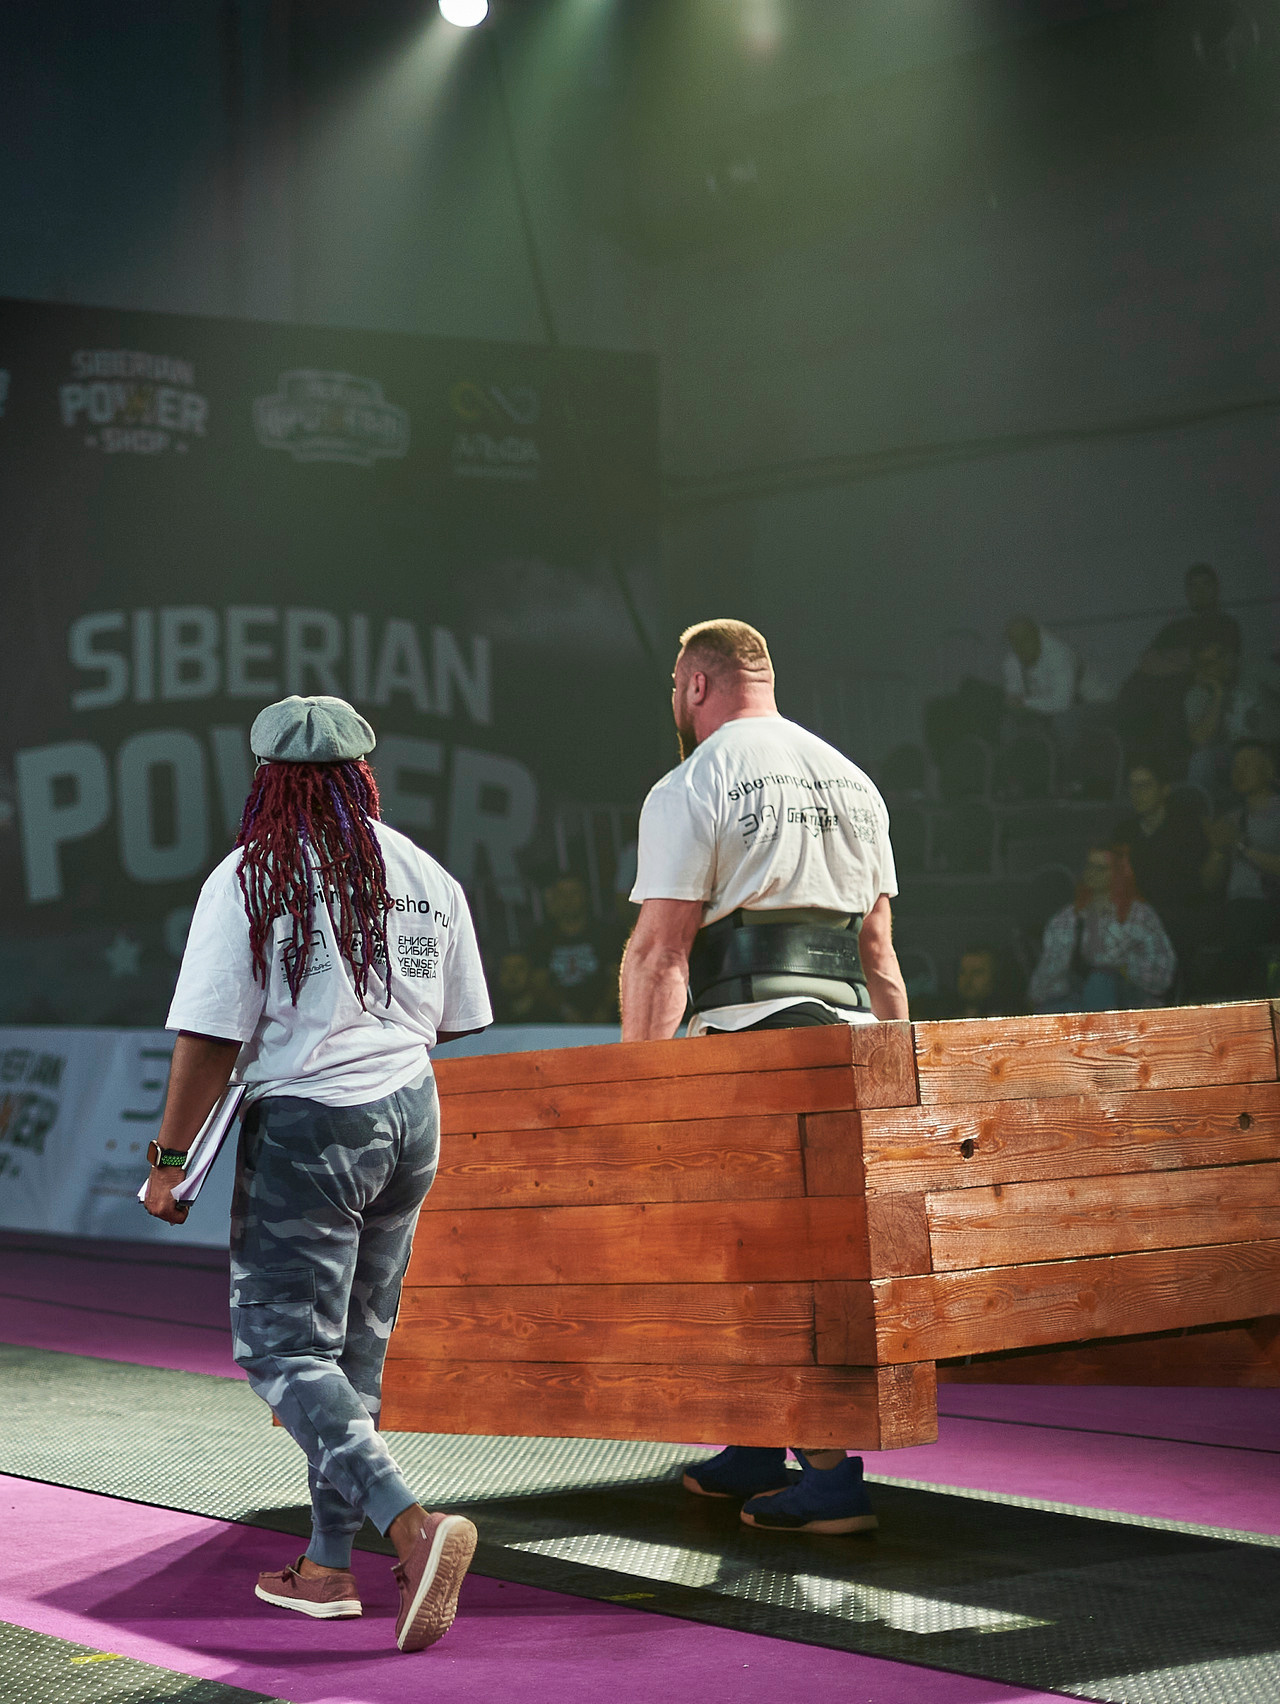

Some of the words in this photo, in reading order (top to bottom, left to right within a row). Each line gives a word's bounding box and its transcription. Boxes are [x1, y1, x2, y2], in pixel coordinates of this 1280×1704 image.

[68, 605, 492, 726] SIBERIAN
[16, 727, 537, 912] POER
[397, 944, 439, 957] СИБИРЬ
[397, 956, 438, 969] YENISEY
[401, 967, 437, 979] SIBERIA
